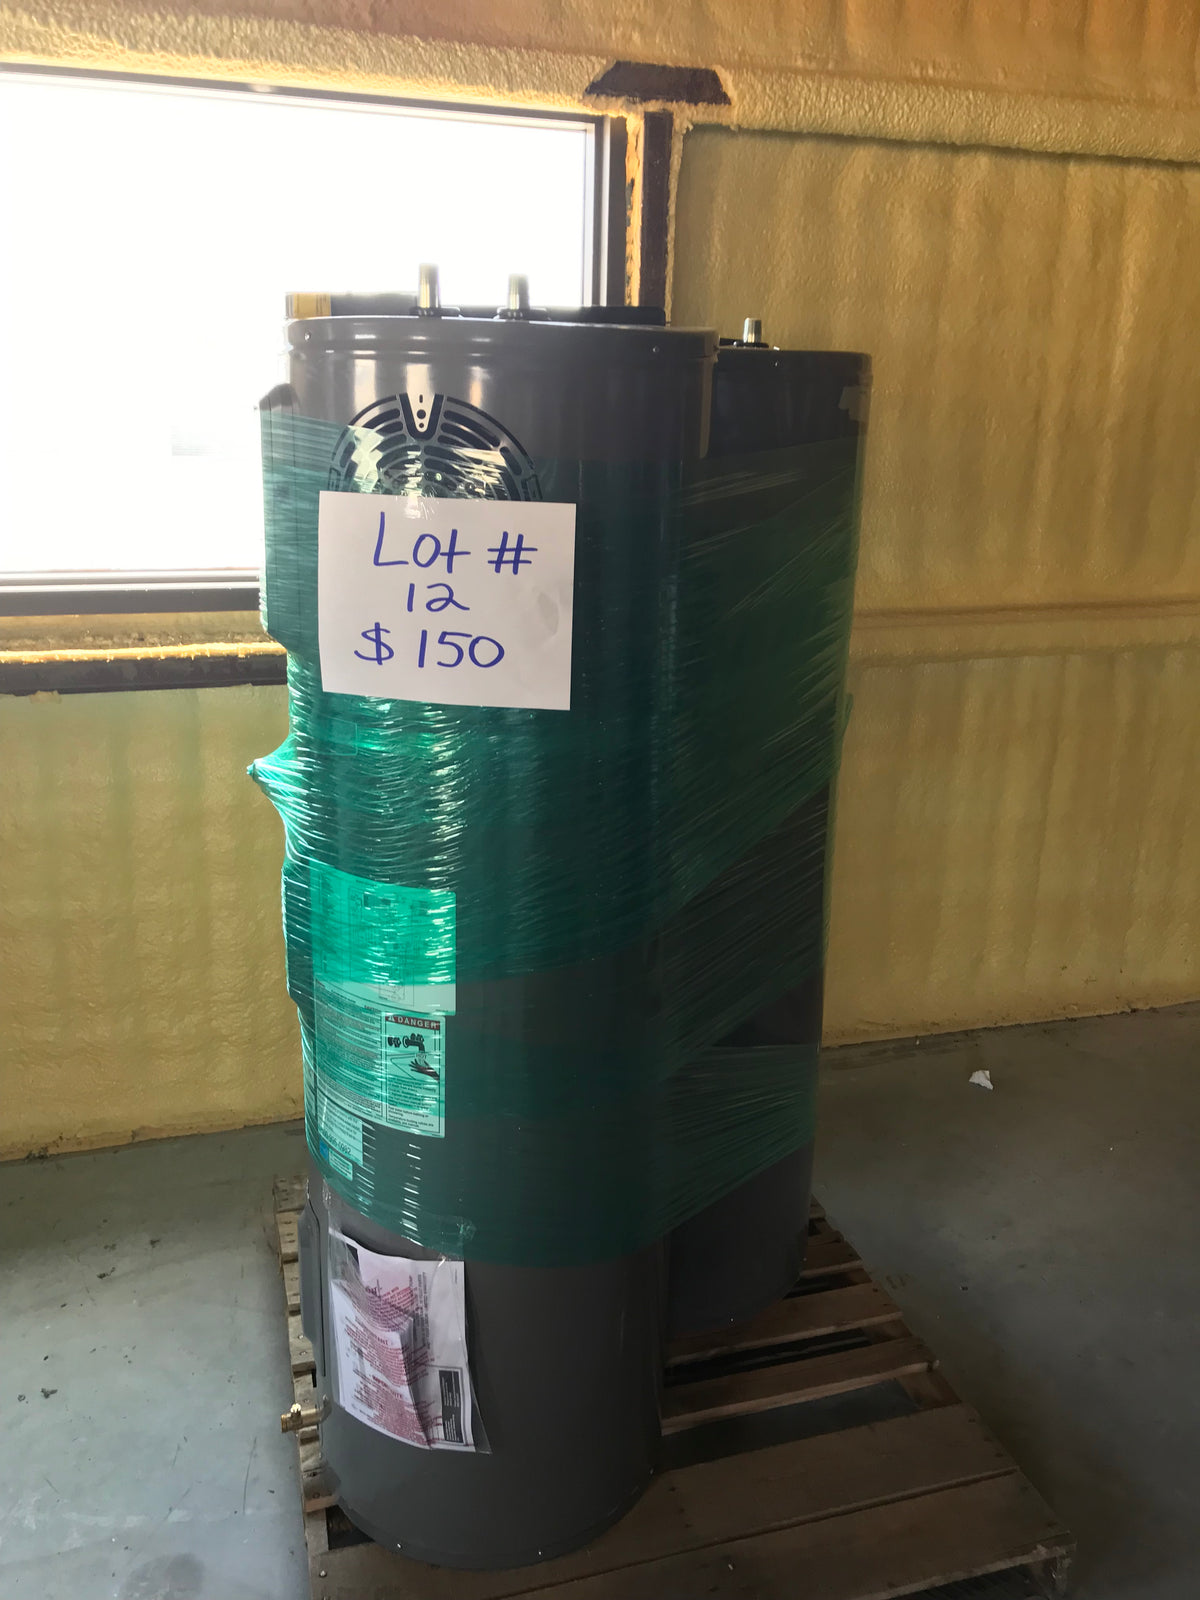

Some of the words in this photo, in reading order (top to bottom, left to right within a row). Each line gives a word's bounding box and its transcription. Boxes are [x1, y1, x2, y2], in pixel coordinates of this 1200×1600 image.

[487, 530, 538, 575] #
[406, 582, 470, 612] 12
[397, 1016, 437, 1029] DANGER
